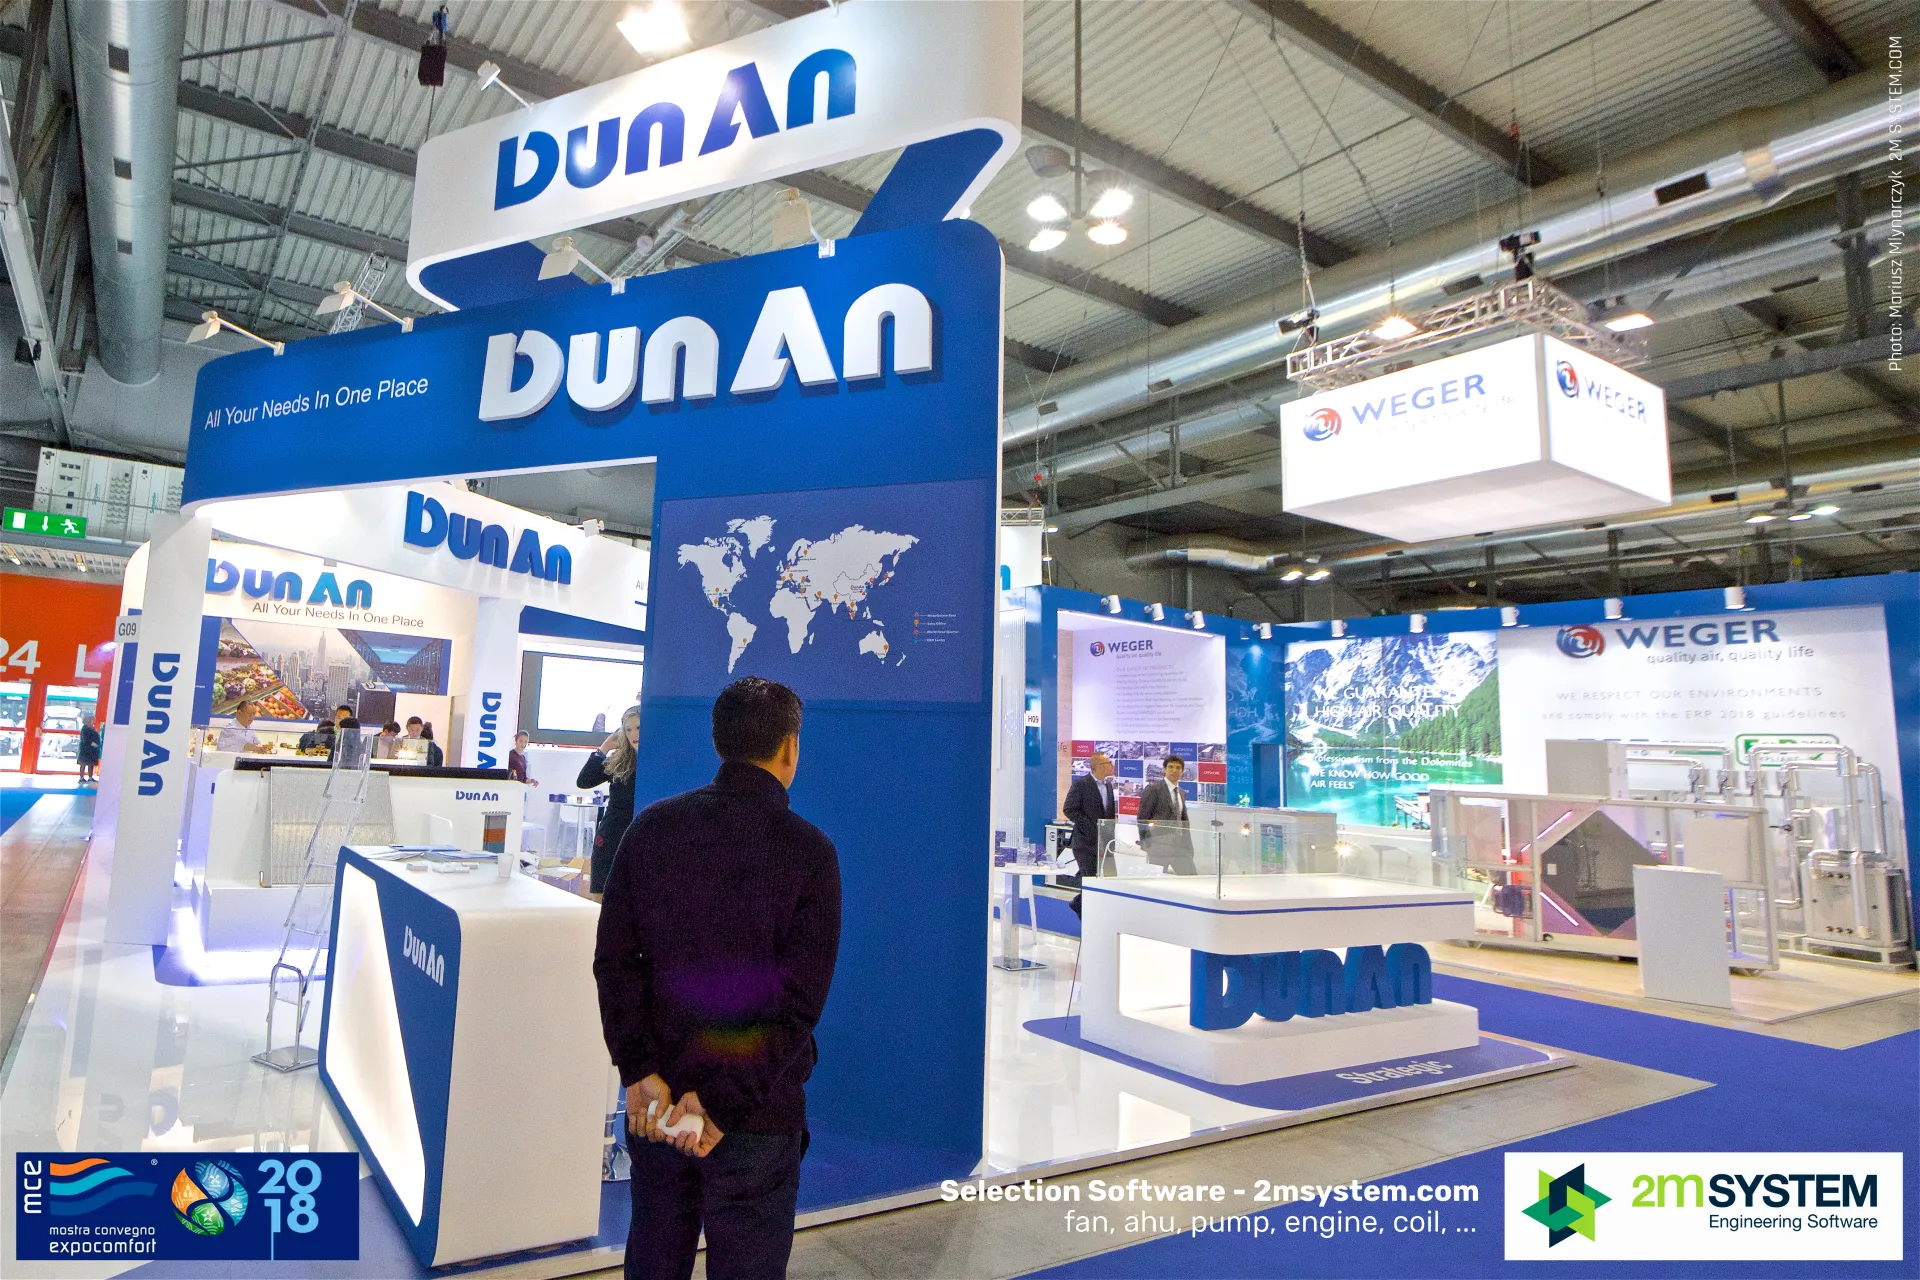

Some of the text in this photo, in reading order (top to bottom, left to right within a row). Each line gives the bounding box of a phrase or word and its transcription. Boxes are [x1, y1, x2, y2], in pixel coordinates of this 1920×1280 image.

[204, 378, 429, 430] All Your Needs In One Place
[1351, 373, 1487, 426] WEGER
[1584, 376, 1647, 424] WEGER
[252, 602, 424, 628] All Your Needs In One Place
[118, 622, 137, 636] G09
[1616, 618, 1781, 650] WEGER
[1108, 639, 1154, 653] WEGER
[1646, 645, 1815, 664] quality air, quality life
[1556, 686, 1824, 701] WE RESPECT OUR ENVIRONMENTS
[1358, 704, 1382, 718] AIR
[1388, 703, 1462, 719] QUALITY
[1542, 708, 1847, 722] and comply with the ERP 2018 guidelines
[1027, 715, 1040, 724] H09
[477, 691, 502, 769] DunA
[1310, 755, 1474, 768] rofessionalism from the Dolomites
[1328, 769, 1361, 780] KNOW
[1363, 770, 1391, 782] HOW
[1395, 771, 1431, 783] GOOD
[1310, 780, 1355, 790] AIR FEELS
[1335, 1060, 1454, 1085] Strategic
